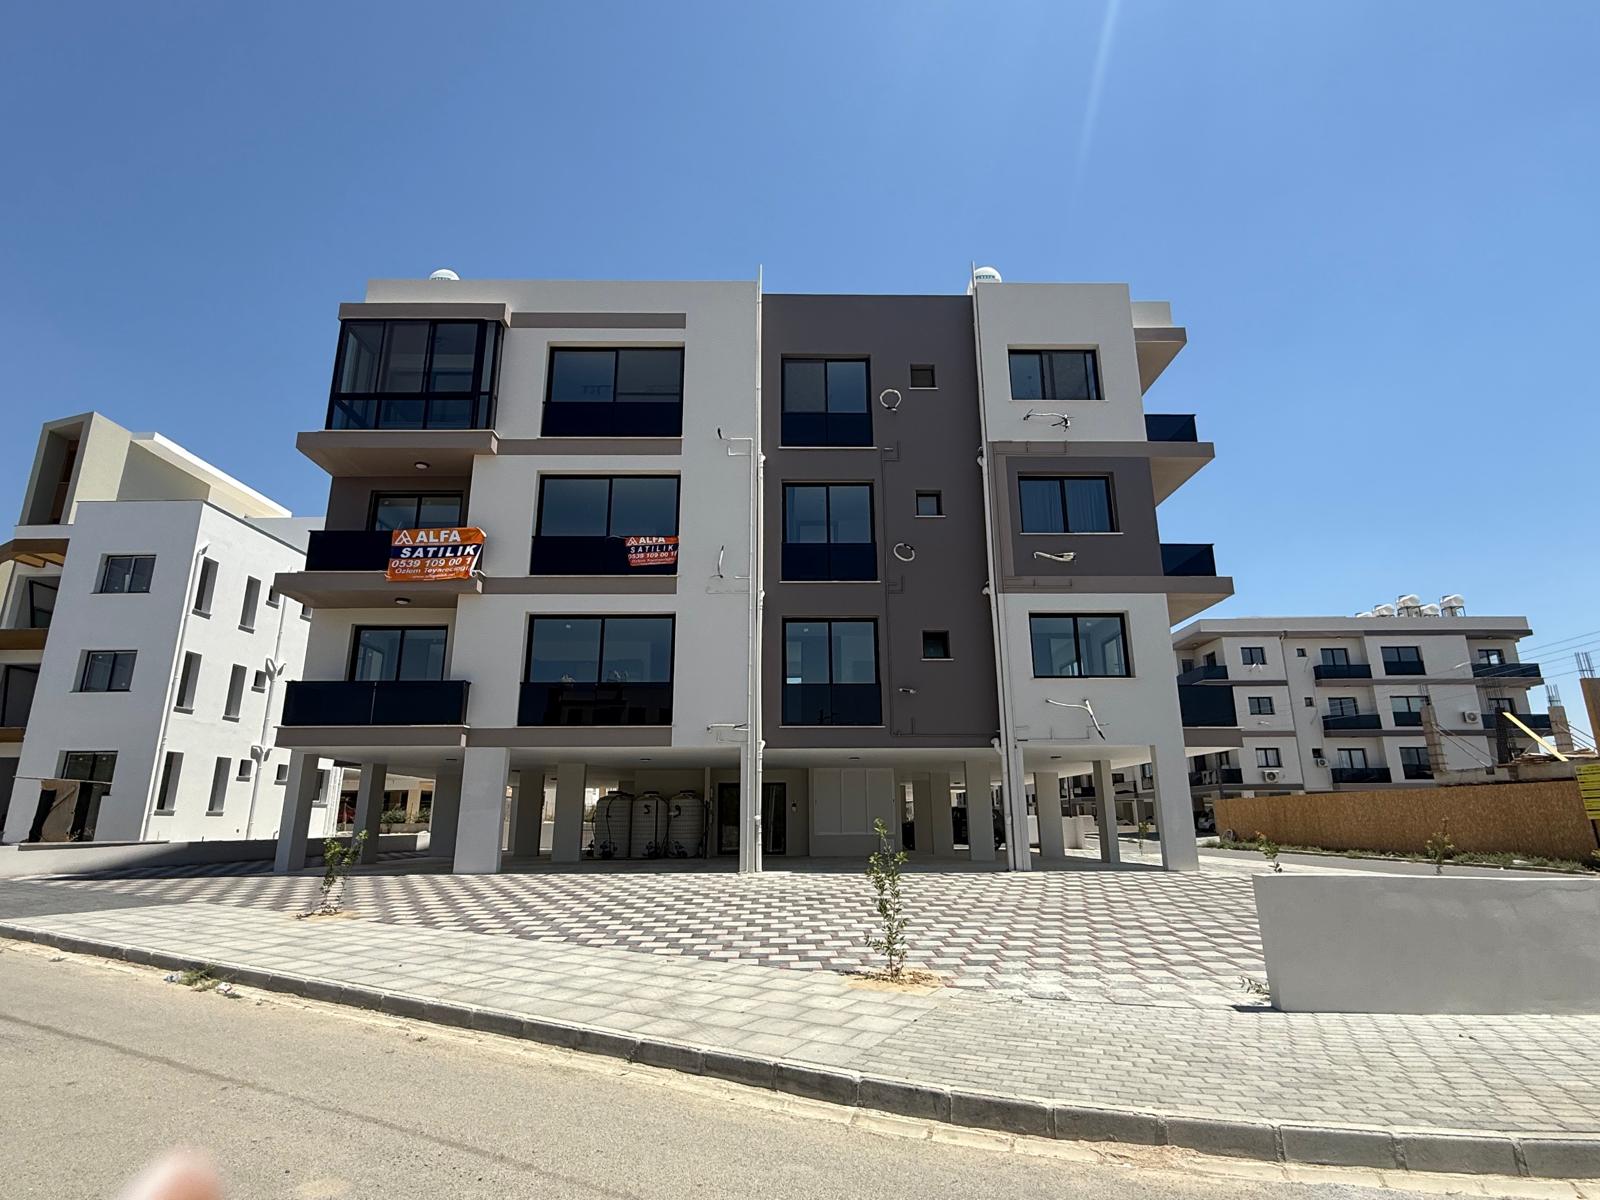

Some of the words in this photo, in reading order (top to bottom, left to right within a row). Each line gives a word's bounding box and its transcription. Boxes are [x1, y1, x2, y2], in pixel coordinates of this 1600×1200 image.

[416, 530, 461, 542] ALFA
[400, 544, 478, 558] SATILIK
[630, 545, 674, 553] SATILIK
[392, 560, 420, 568] 0539
[425, 559, 446, 567] 109
[448, 557, 462, 566] 00
